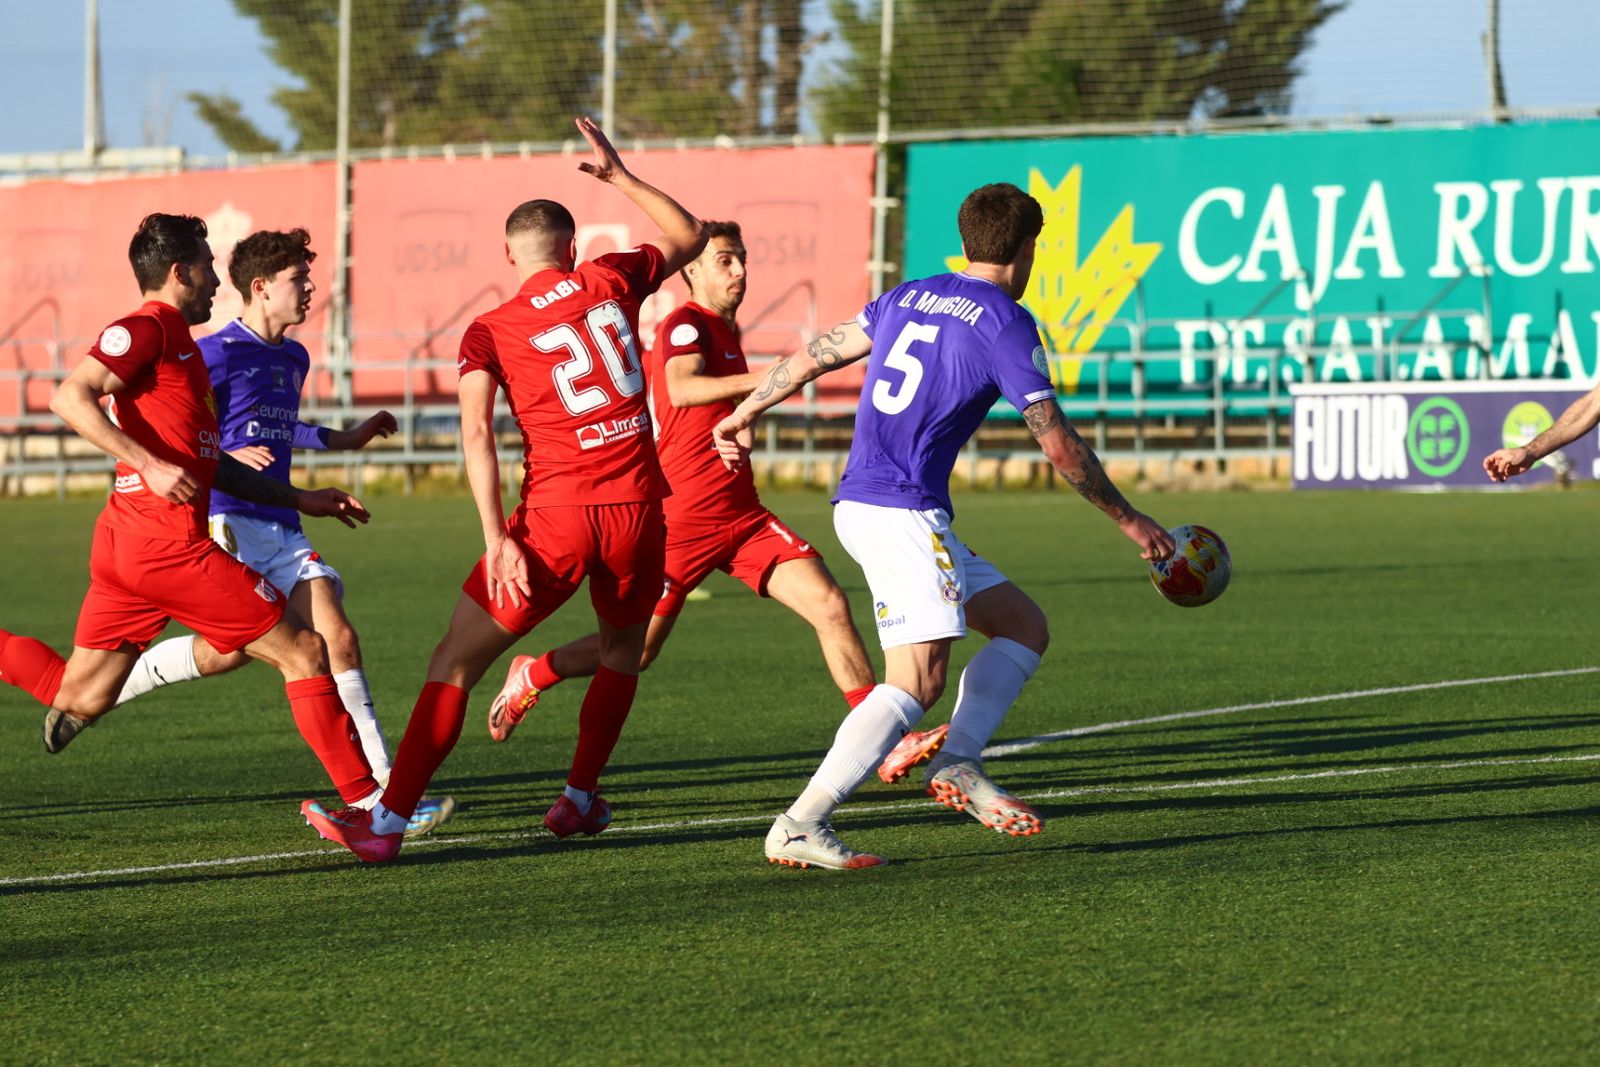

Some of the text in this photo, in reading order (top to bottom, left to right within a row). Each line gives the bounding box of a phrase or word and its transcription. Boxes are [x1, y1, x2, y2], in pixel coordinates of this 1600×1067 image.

[748, 233, 817, 266] DSM
[1178, 180, 1405, 311] CAJA
[530, 279, 582, 309] GABI
[913, 290, 985, 327] MUNGUIA
[529, 299, 644, 417] 20
[872, 320, 941, 416] 5
[929, 532, 955, 571] 5
